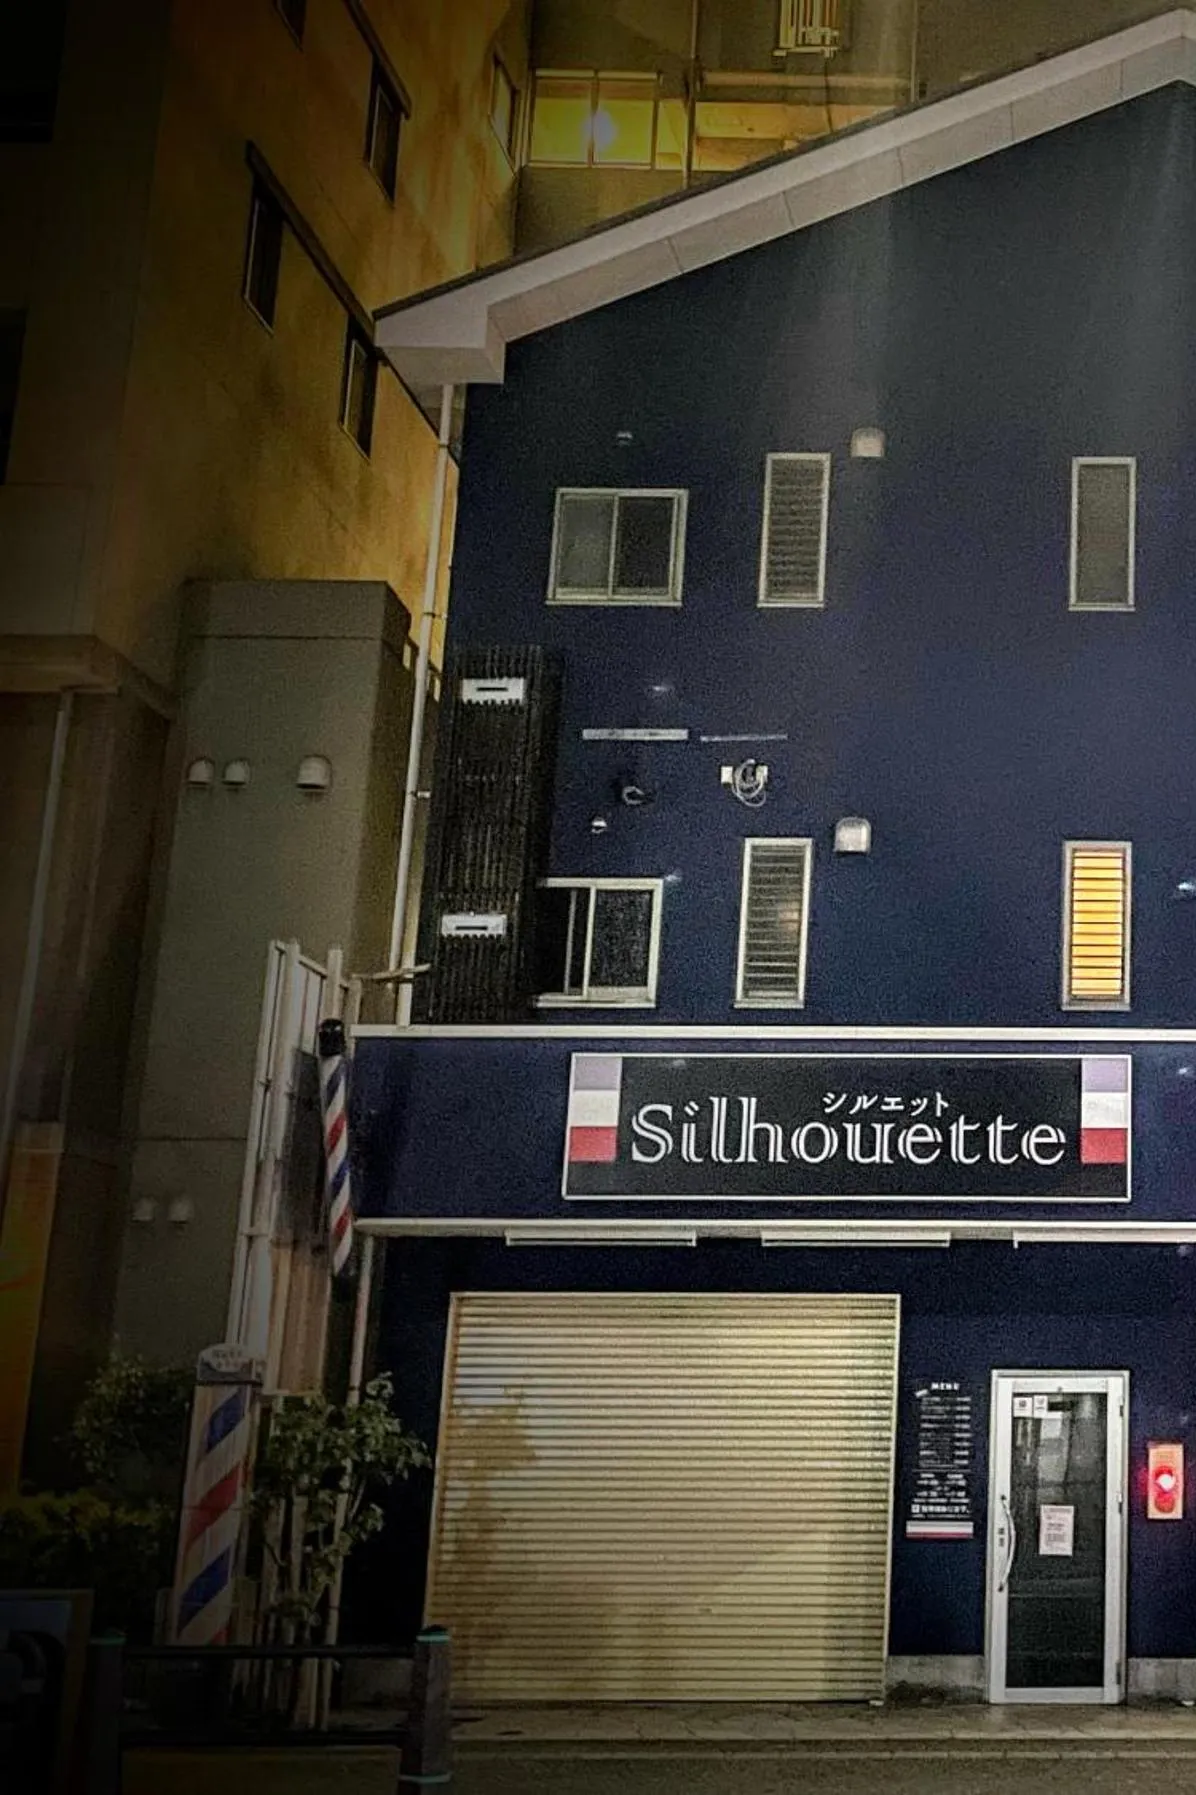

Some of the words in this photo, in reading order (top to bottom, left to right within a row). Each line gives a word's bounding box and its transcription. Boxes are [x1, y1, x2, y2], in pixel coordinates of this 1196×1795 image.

[821, 1092, 949, 1116] シルエット
[631, 1096, 1067, 1165] Silhouette
